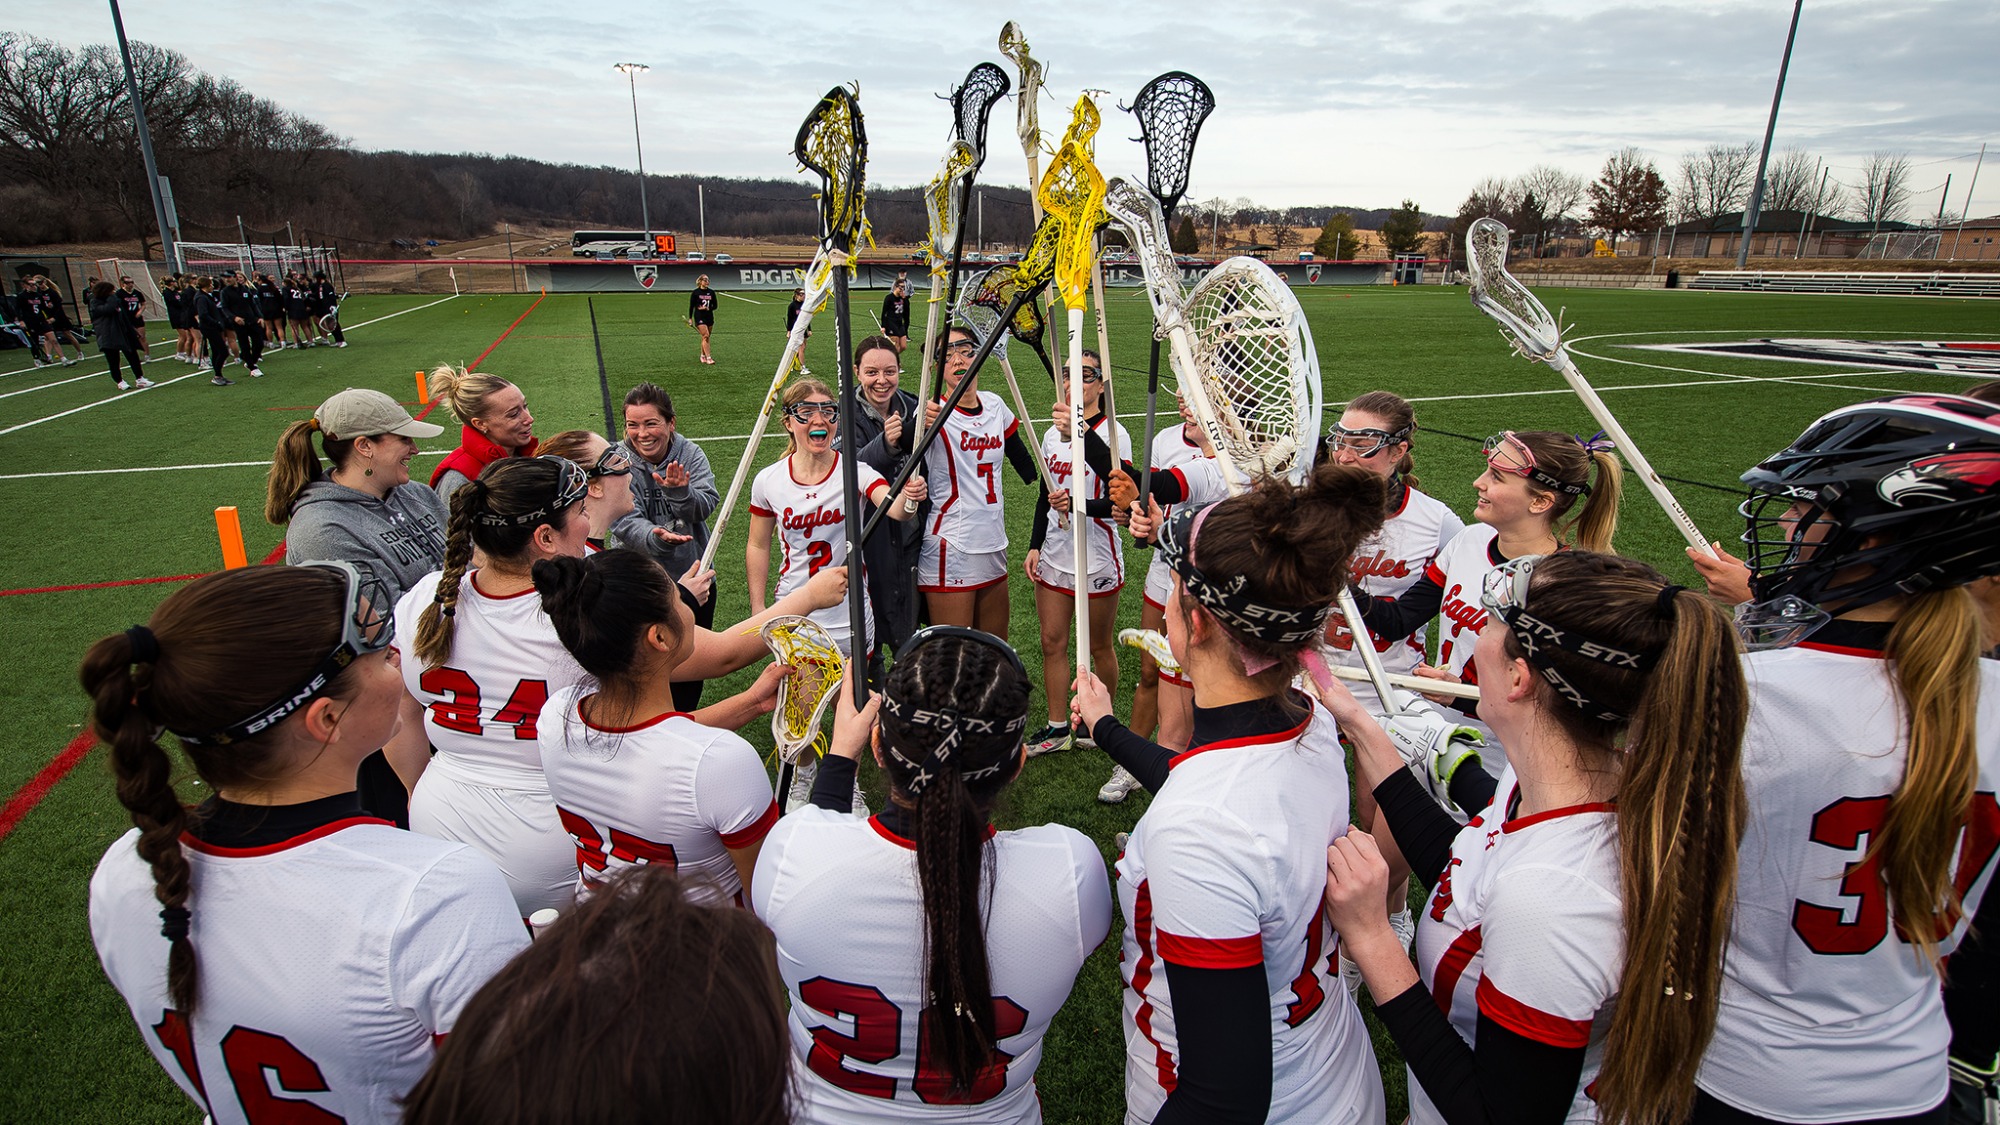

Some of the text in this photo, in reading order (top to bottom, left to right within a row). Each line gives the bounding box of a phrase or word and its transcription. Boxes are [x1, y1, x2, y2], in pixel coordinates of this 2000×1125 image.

[656, 235, 675, 252] 90
[960, 431, 1002, 460] Eagles
[1206, 420, 1225, 451] GAIT
[977, 462, 997, 504] 7
[1536, 472, 1562, 489] STX
[481, 508, 547, 526] STX STX
[782, 505, 845, 539] Eagles
[807, 540, 833, 578] 2
[1210, 607, 1266, 638] STX
[1242, 604, 1302, 624] STX
[1515, 612, 1641, 668] STX STX
[246, 673, 327, 734] BRINE
[1541, 667, 1590, 709] STX
[961, 717, 995, 734] TX
